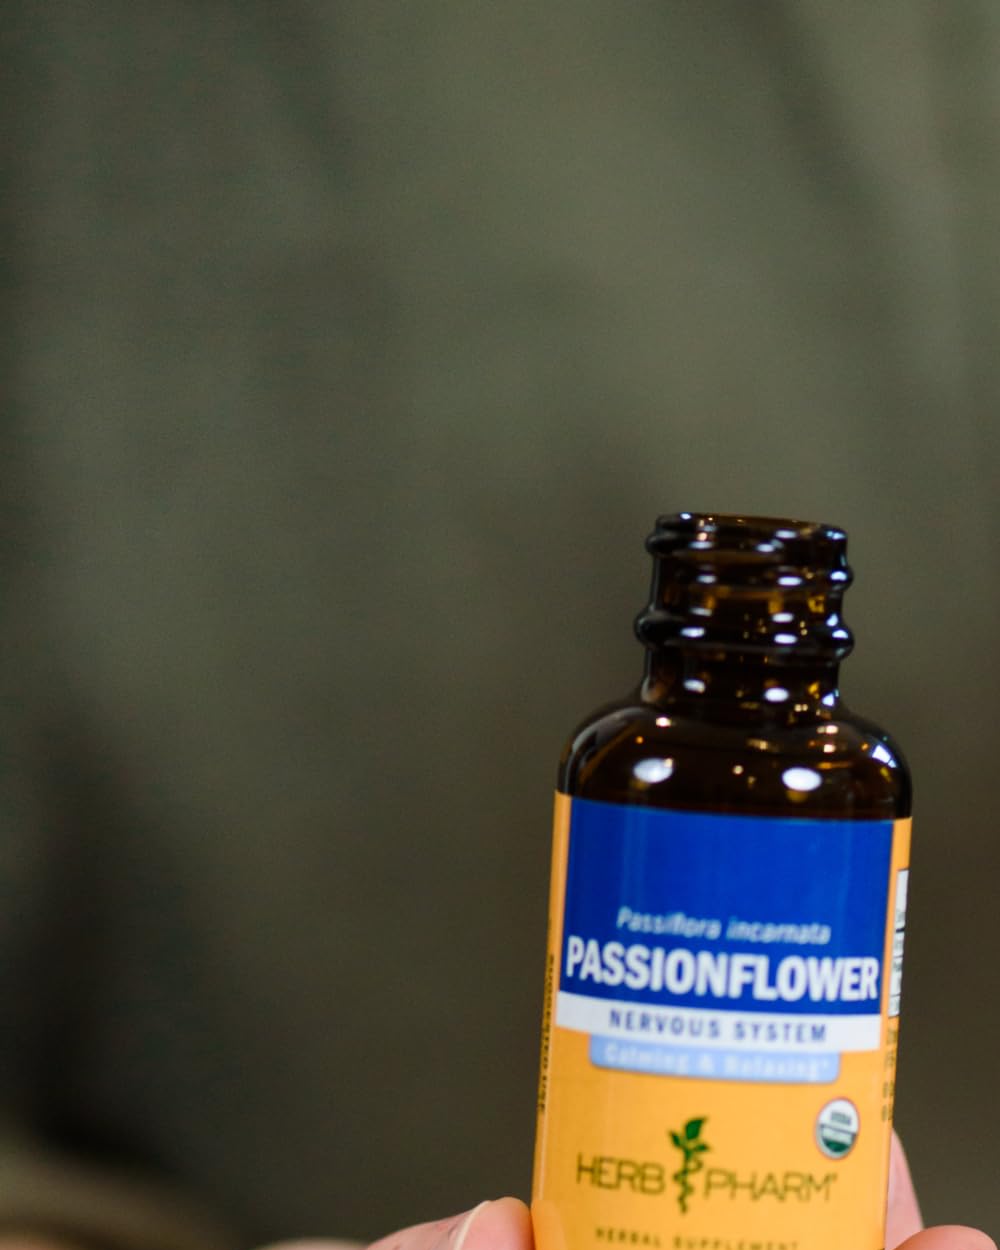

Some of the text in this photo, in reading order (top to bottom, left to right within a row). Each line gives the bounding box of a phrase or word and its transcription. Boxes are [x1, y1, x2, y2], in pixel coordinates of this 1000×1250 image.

[617, 905, 831, 945] Passiflora incarnata
[565, 934, 879, 1003] PASSIONFLOWER
[608, 1007, 827, 1043] NERVOUS SYSTEM
[575, 1153, 665, 1196] HERB
[595, 1226, 661, 1249] HERBAL
